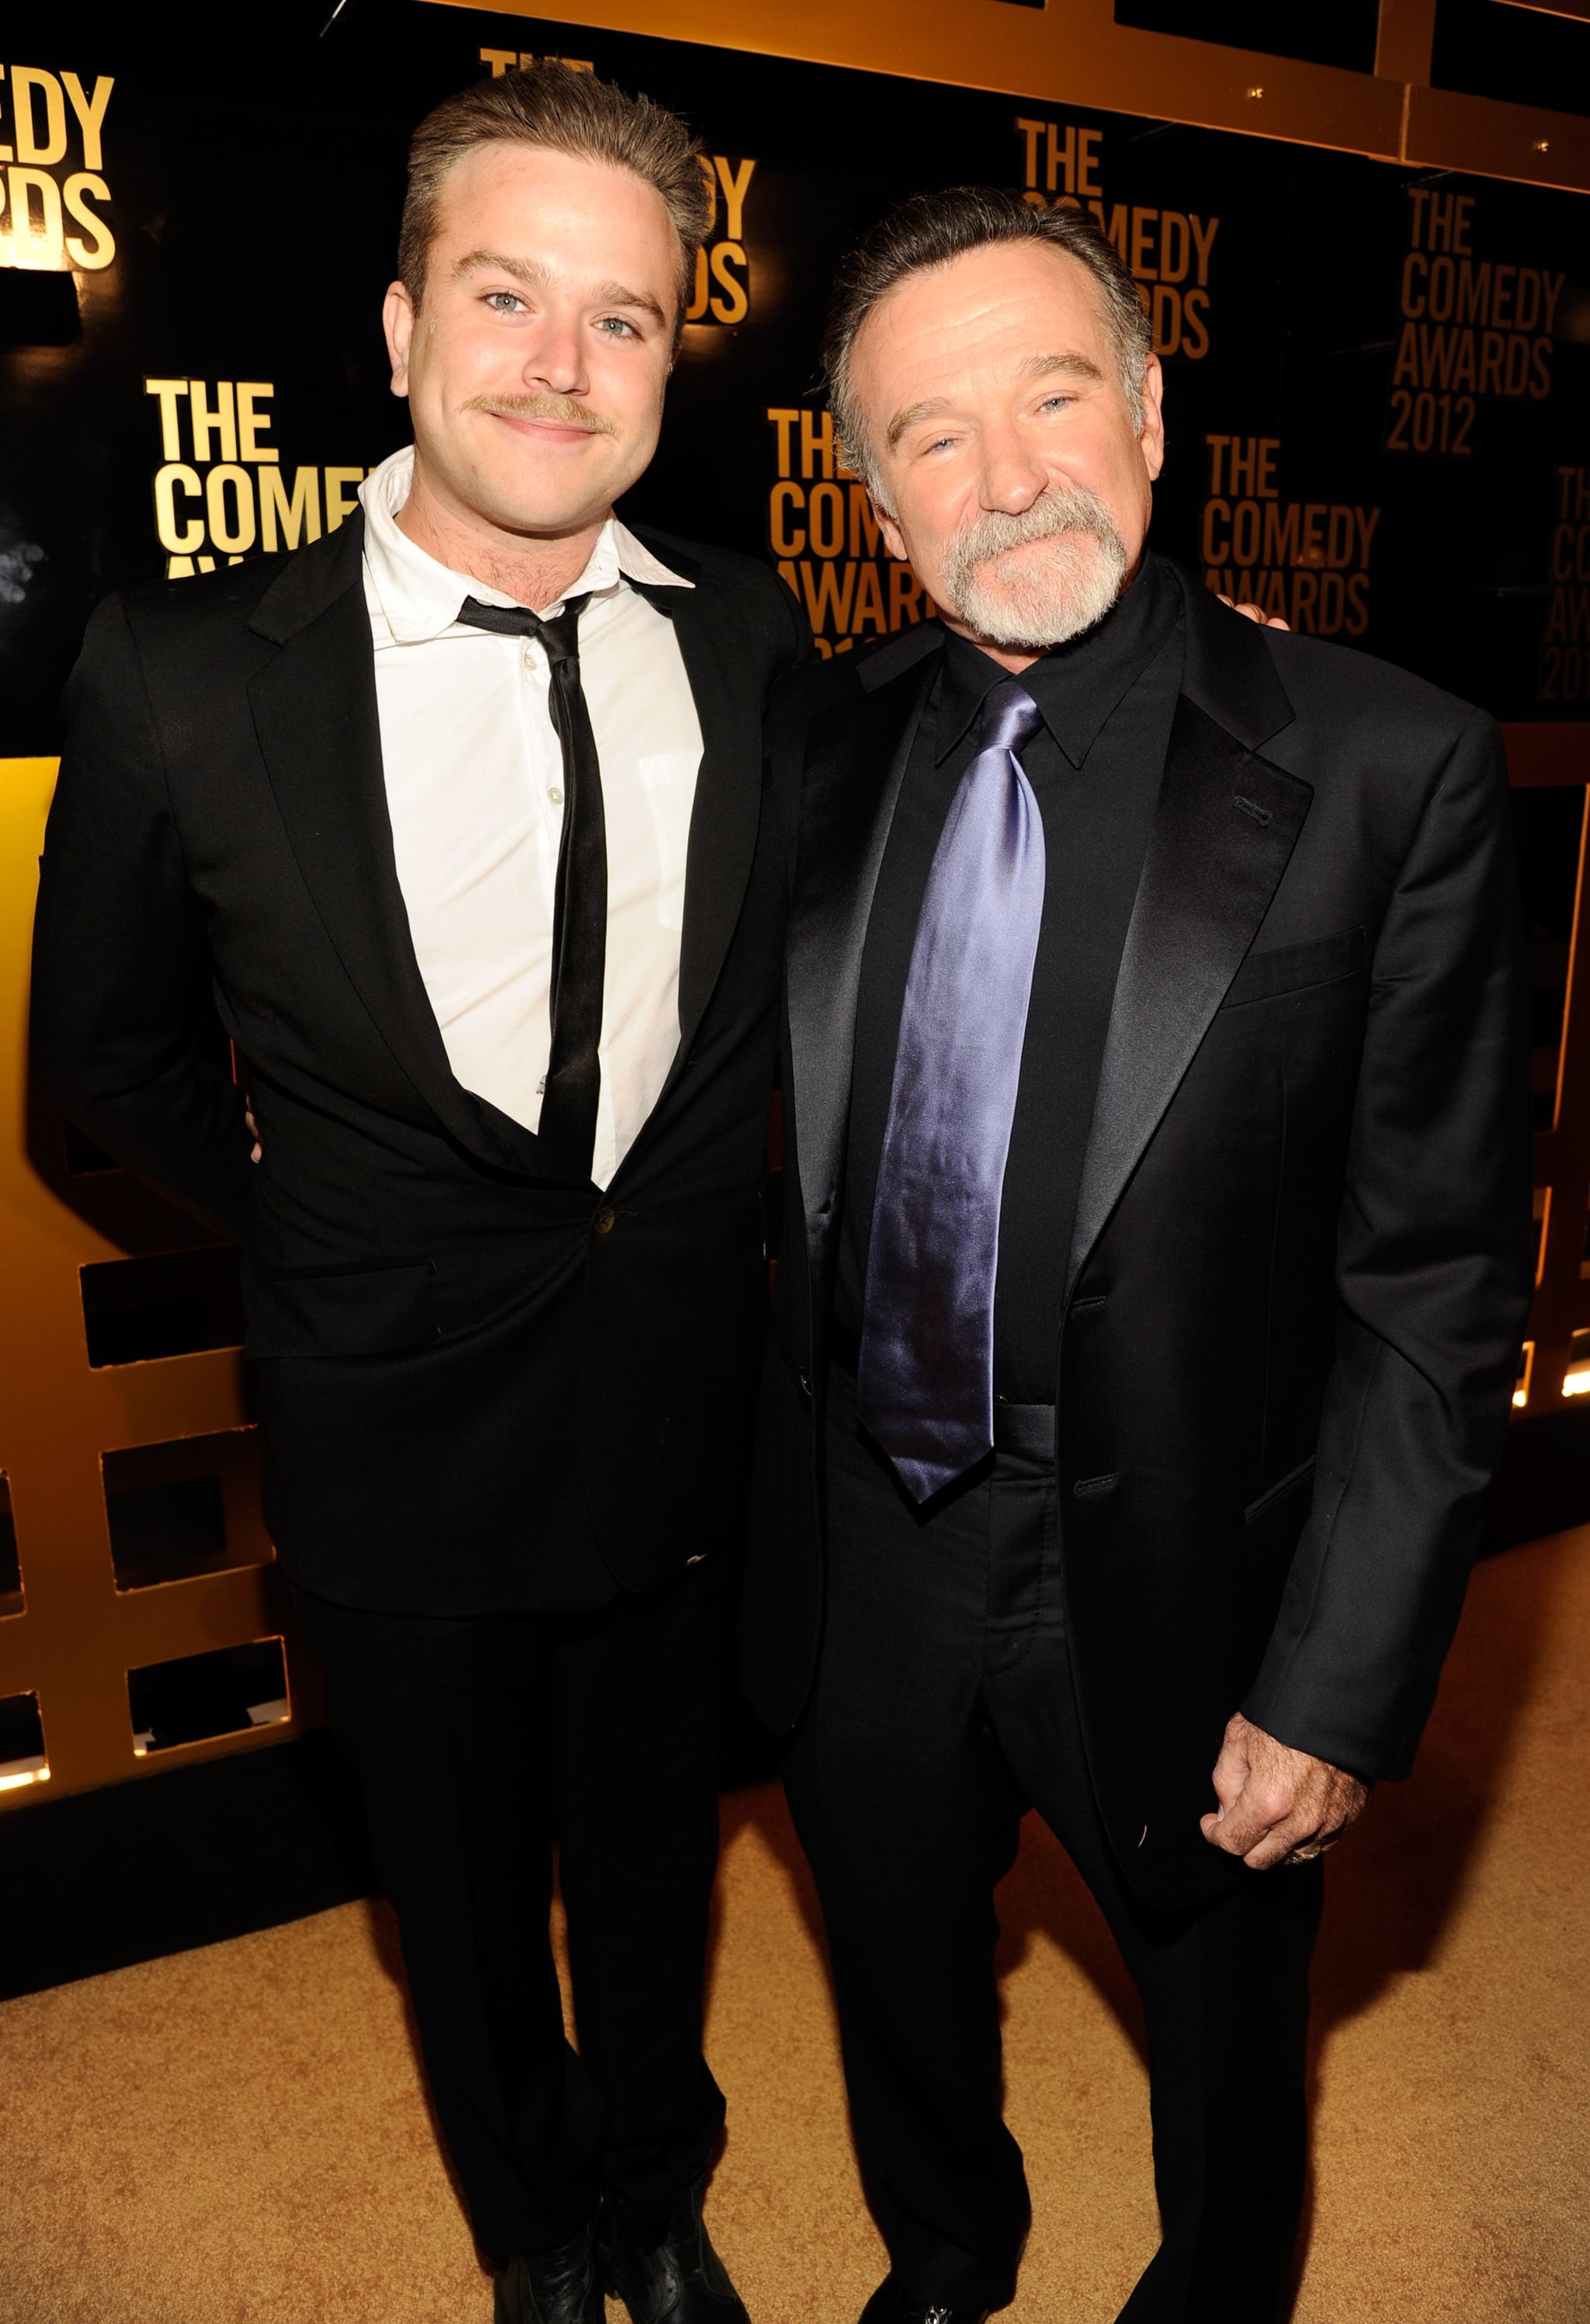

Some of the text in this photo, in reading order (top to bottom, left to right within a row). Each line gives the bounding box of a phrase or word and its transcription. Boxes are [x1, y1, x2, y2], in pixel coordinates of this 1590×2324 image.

[1017, 118, 1102, 197] THE
[1408, 187, 1475, 255] THE
[1401, 252, 1565, 333] COMEDY
[1393, 322, 1554, 399] AWARDS
[146, 380, 279, 461] THE
[1387, 390, 1476, 454] 2012
[1206, 434, 1279, 498] THE
[1203, 498, 1381, 569] COMEDY
